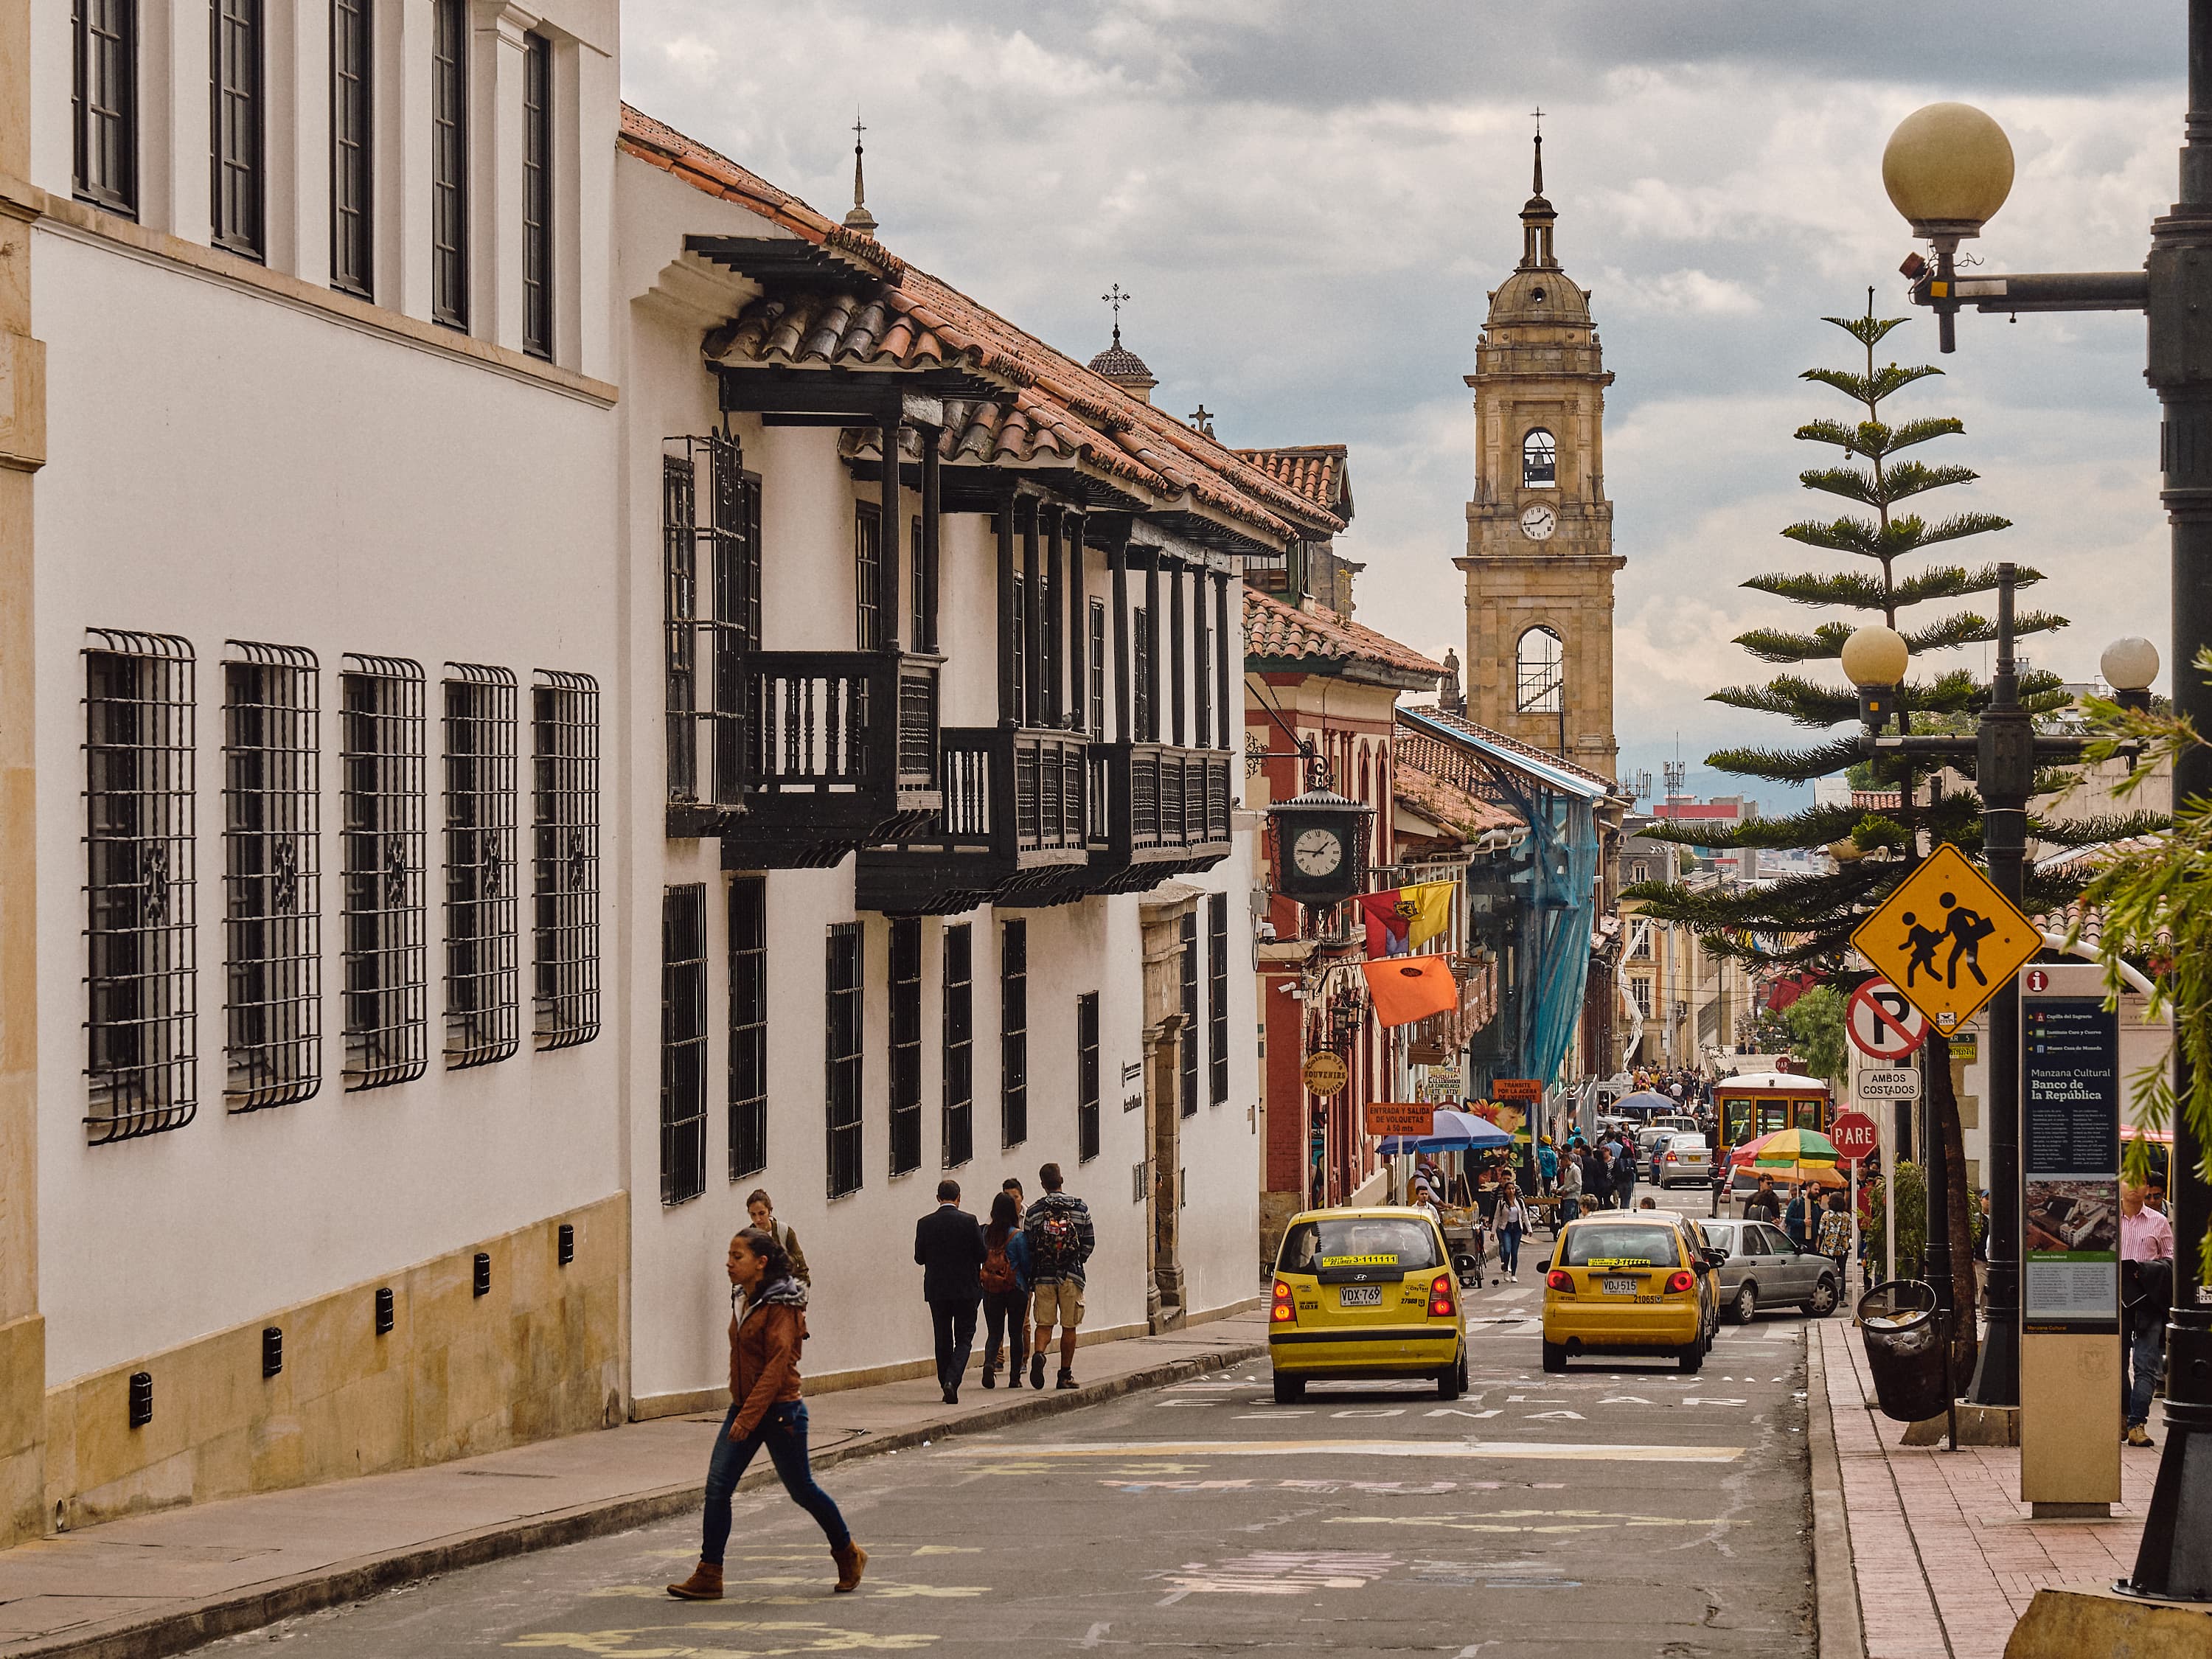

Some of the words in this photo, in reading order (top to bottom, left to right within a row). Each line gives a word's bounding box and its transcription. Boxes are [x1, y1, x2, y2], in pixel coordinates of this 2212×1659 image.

[2074, 1068, 2110, 1077] Cultural
[1871, 1074, 1906, 1082] AMBOS
[2031, 1080, 2067, 1089] Banco
[2070, 1079, 2084, 1089] de
[1863, 1085, 1915, 1093] COSTADOS
[2031, 1090, 2042, 1099] la
[2045, 1090, 2102, 1102] República
[1835, 1127, 1873, 1144] PARE
[1634, 1295, 1654, 1304] 21065
[1231, 1409, 1587, 1420] ZONA
